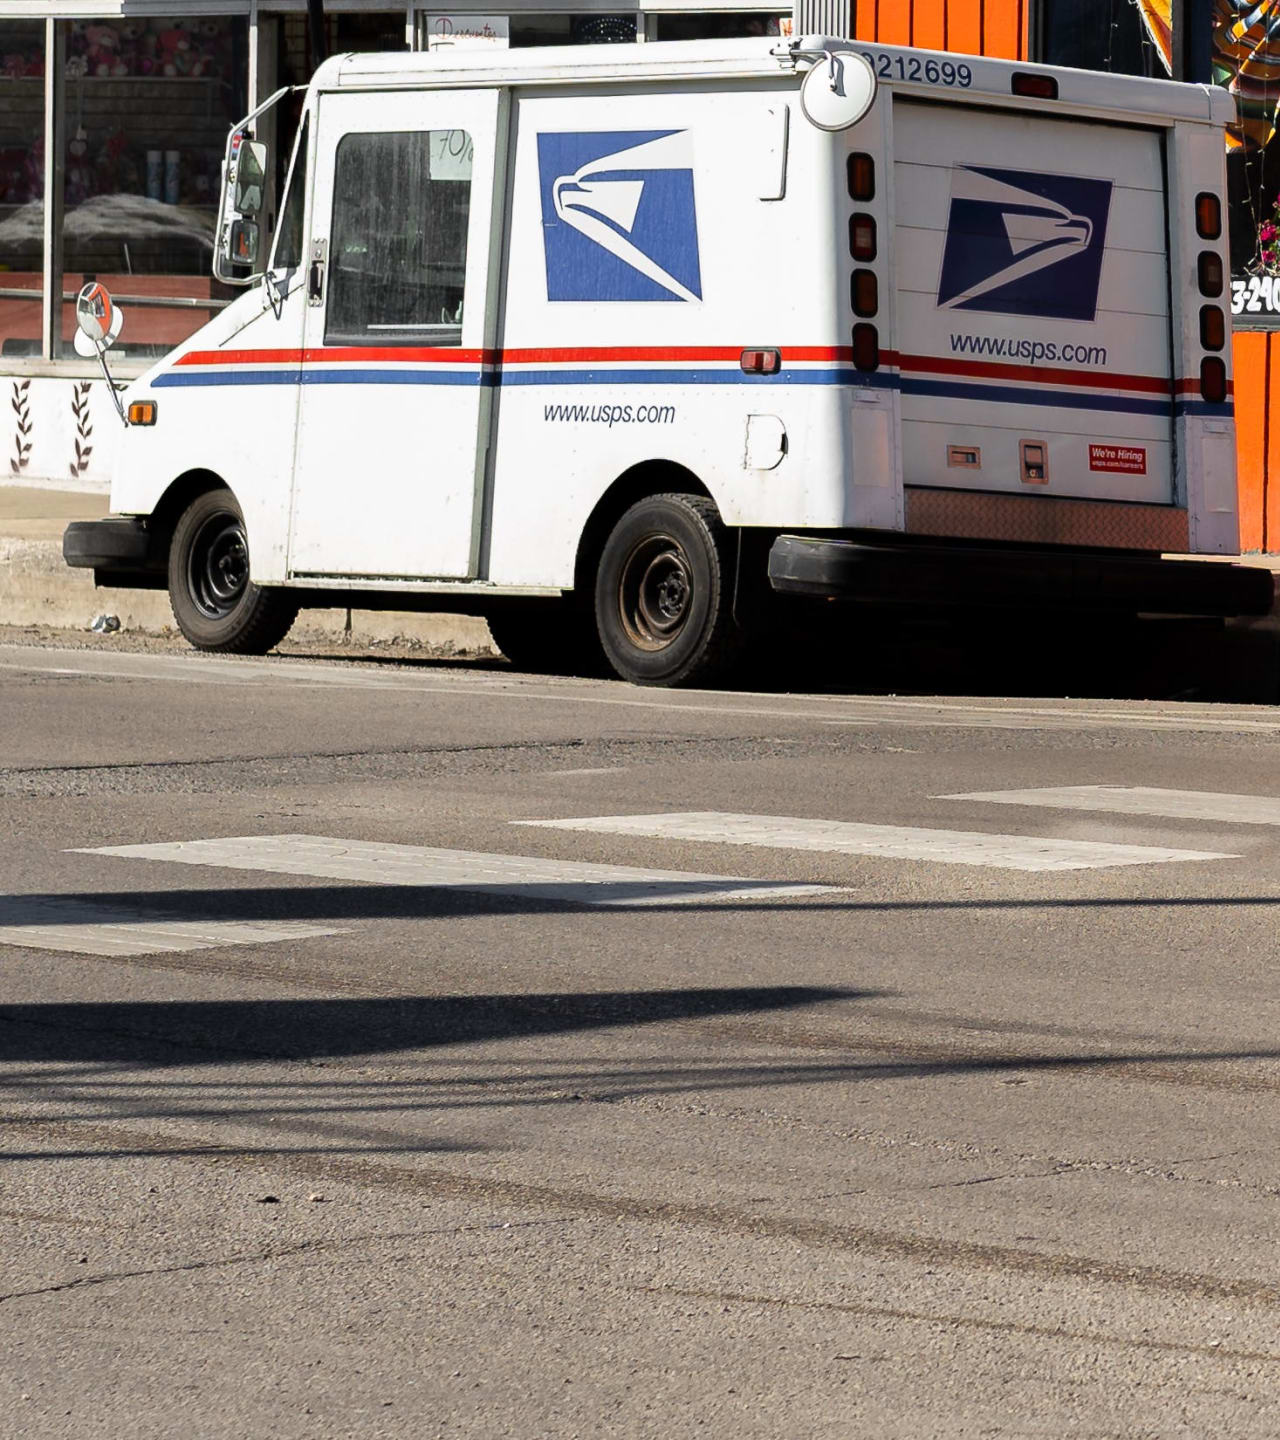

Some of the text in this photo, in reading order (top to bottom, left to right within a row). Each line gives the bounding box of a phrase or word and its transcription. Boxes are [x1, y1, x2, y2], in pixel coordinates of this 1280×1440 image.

[950, 334, 1108, 366] www.usps.com
[544, 404, 676, 428] www.usps.com
[1092, 447, 1143, 462] We're Hiring
